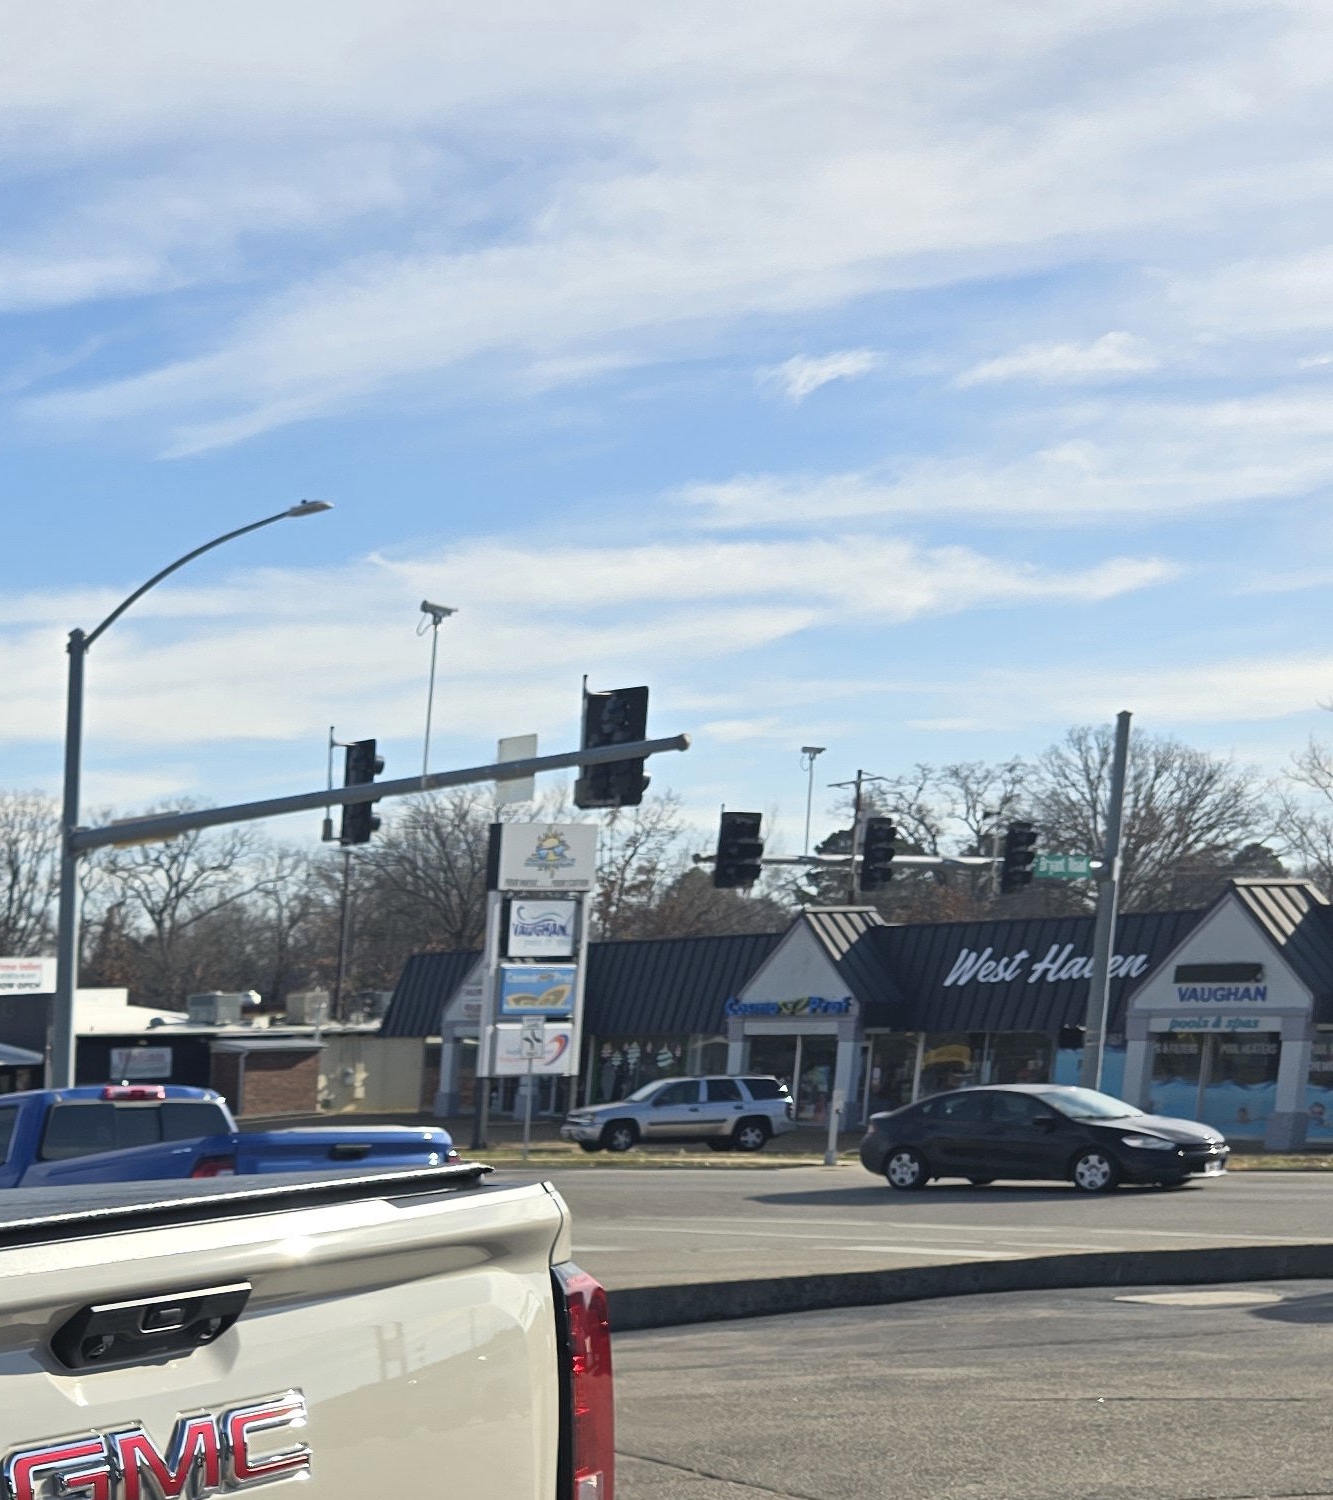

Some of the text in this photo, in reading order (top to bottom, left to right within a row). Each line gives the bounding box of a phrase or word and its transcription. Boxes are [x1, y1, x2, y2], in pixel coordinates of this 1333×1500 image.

[942, 946, 1030, 987] West
[1177, 985, 1268, 1003] VAUGHAN
[1169, 1017, 1209, 1032] pools
[1226, 1018, 1260, 1032] spas
